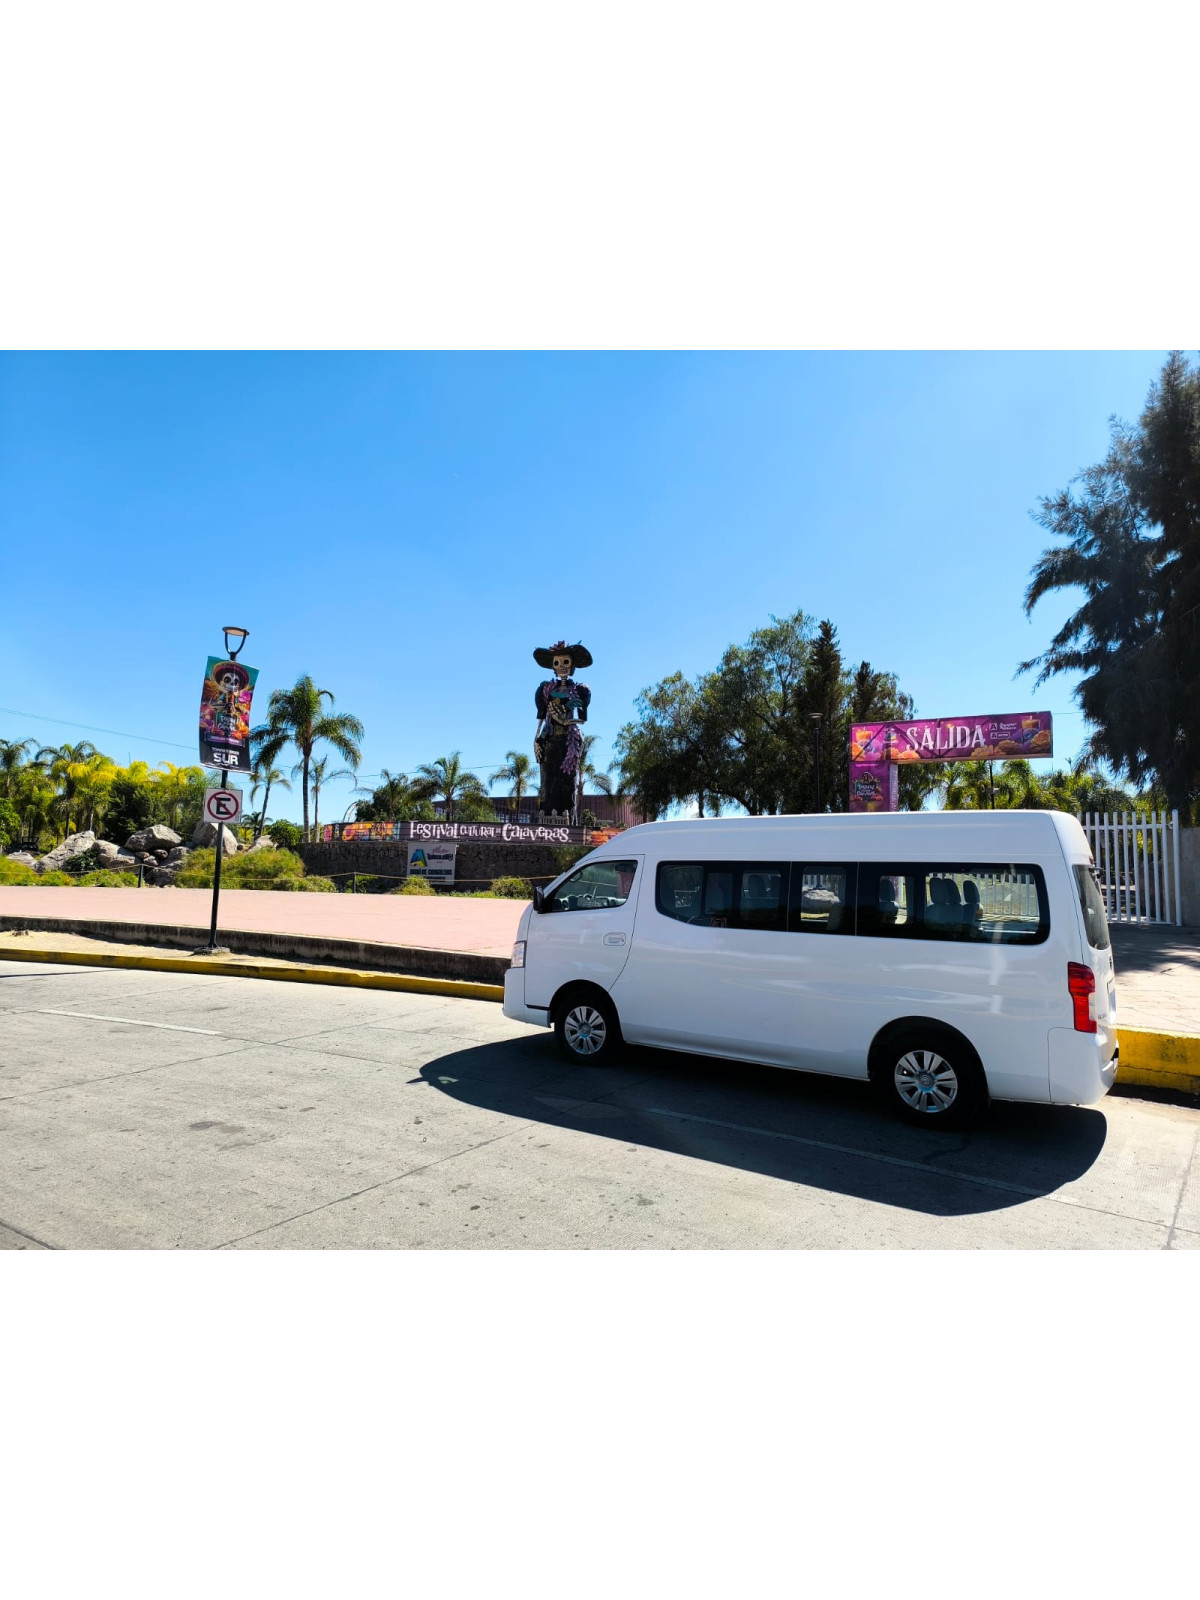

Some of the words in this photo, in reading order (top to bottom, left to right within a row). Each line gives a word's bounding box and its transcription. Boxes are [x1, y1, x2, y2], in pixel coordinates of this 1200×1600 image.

[905, 724, 986, 751] SALIDA
[213, 752, 239, 765] SUR
[216, 797, 231, 815] E
